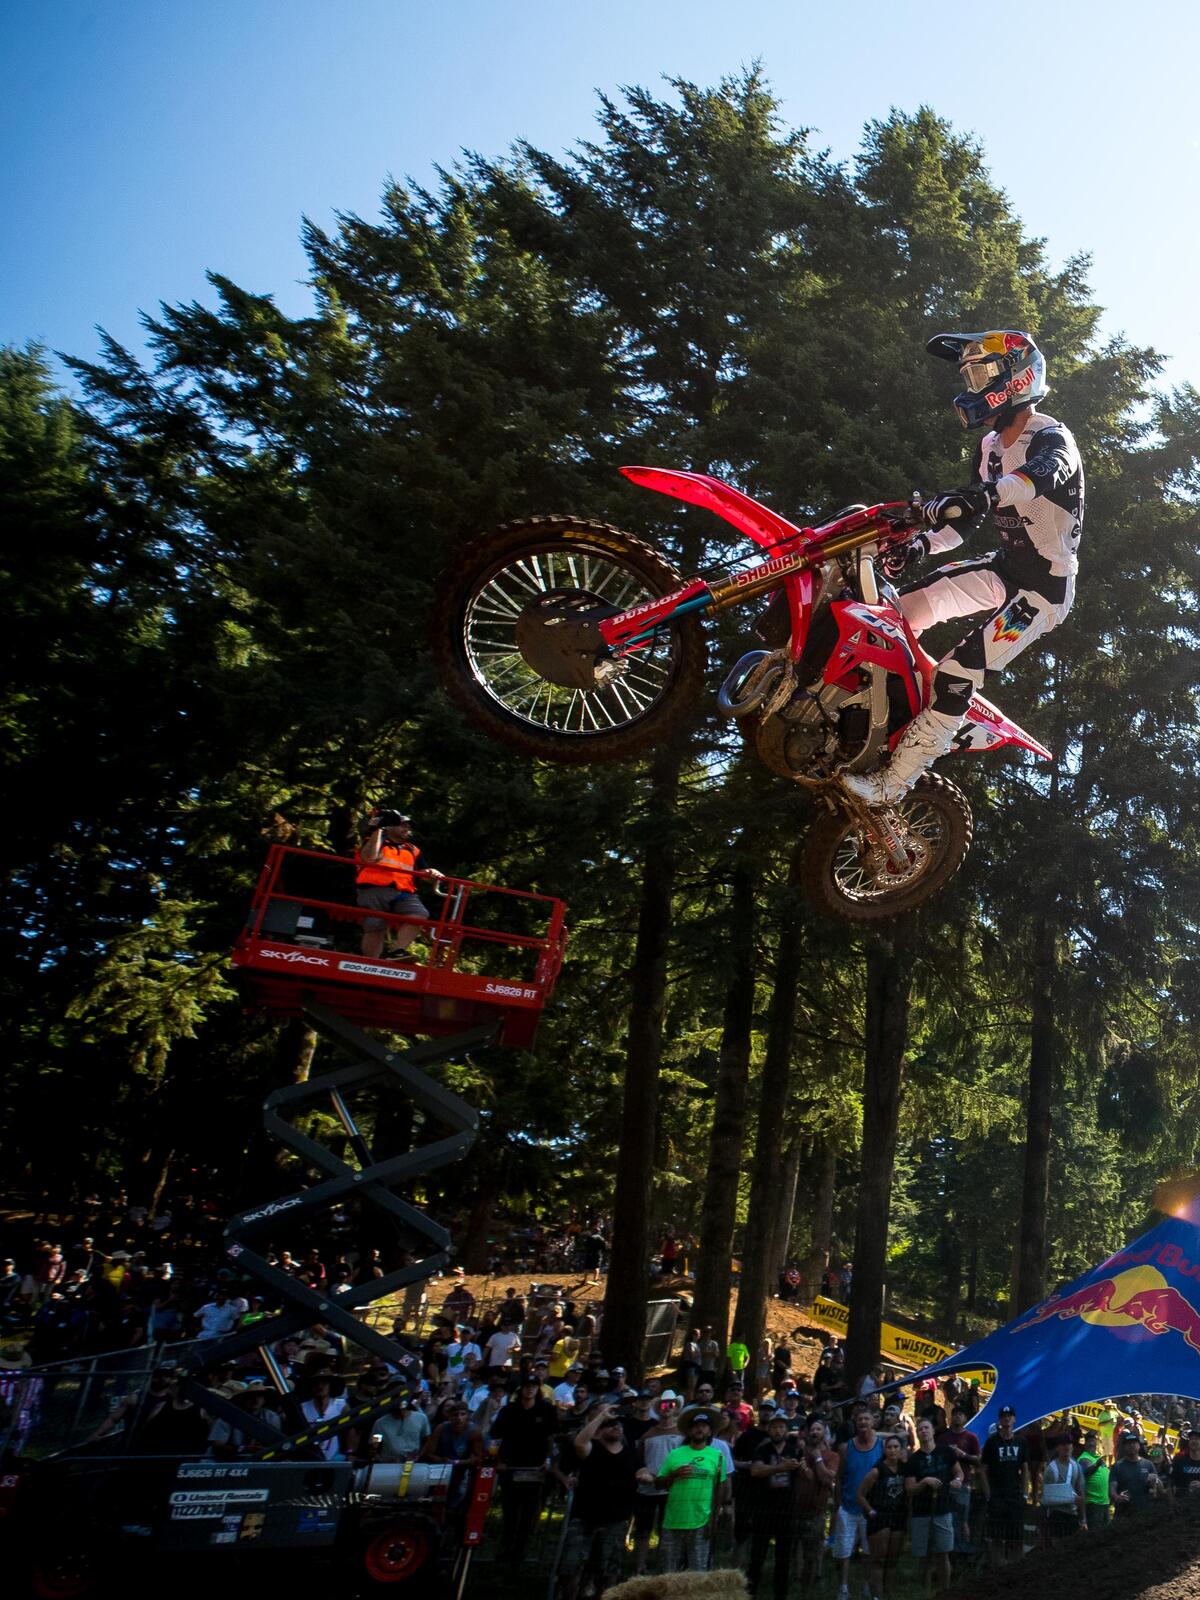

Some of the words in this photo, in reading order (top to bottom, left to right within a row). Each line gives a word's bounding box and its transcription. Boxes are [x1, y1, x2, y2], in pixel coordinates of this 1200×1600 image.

[985, 382, 1014, 409] Red
[1011, 367, 1036, 392] Bull
[737, 554, 795, 588] SHOWA
[612, 591, 684, 626] DUNLOP
[970, 700, 995, 721] ONDA
[259, 949, 330, 967] SKYJACK
[523, 989, 538, 999] RT
[242, 1197, 303, 1223] SKYJACK
[894, 1337, 937, 1358] TWISTED
[998, 1446, 1020, 1458] FLY
[190, 1492, 225, 1501] United
[226, 1490, 264, 1500] Rentals
